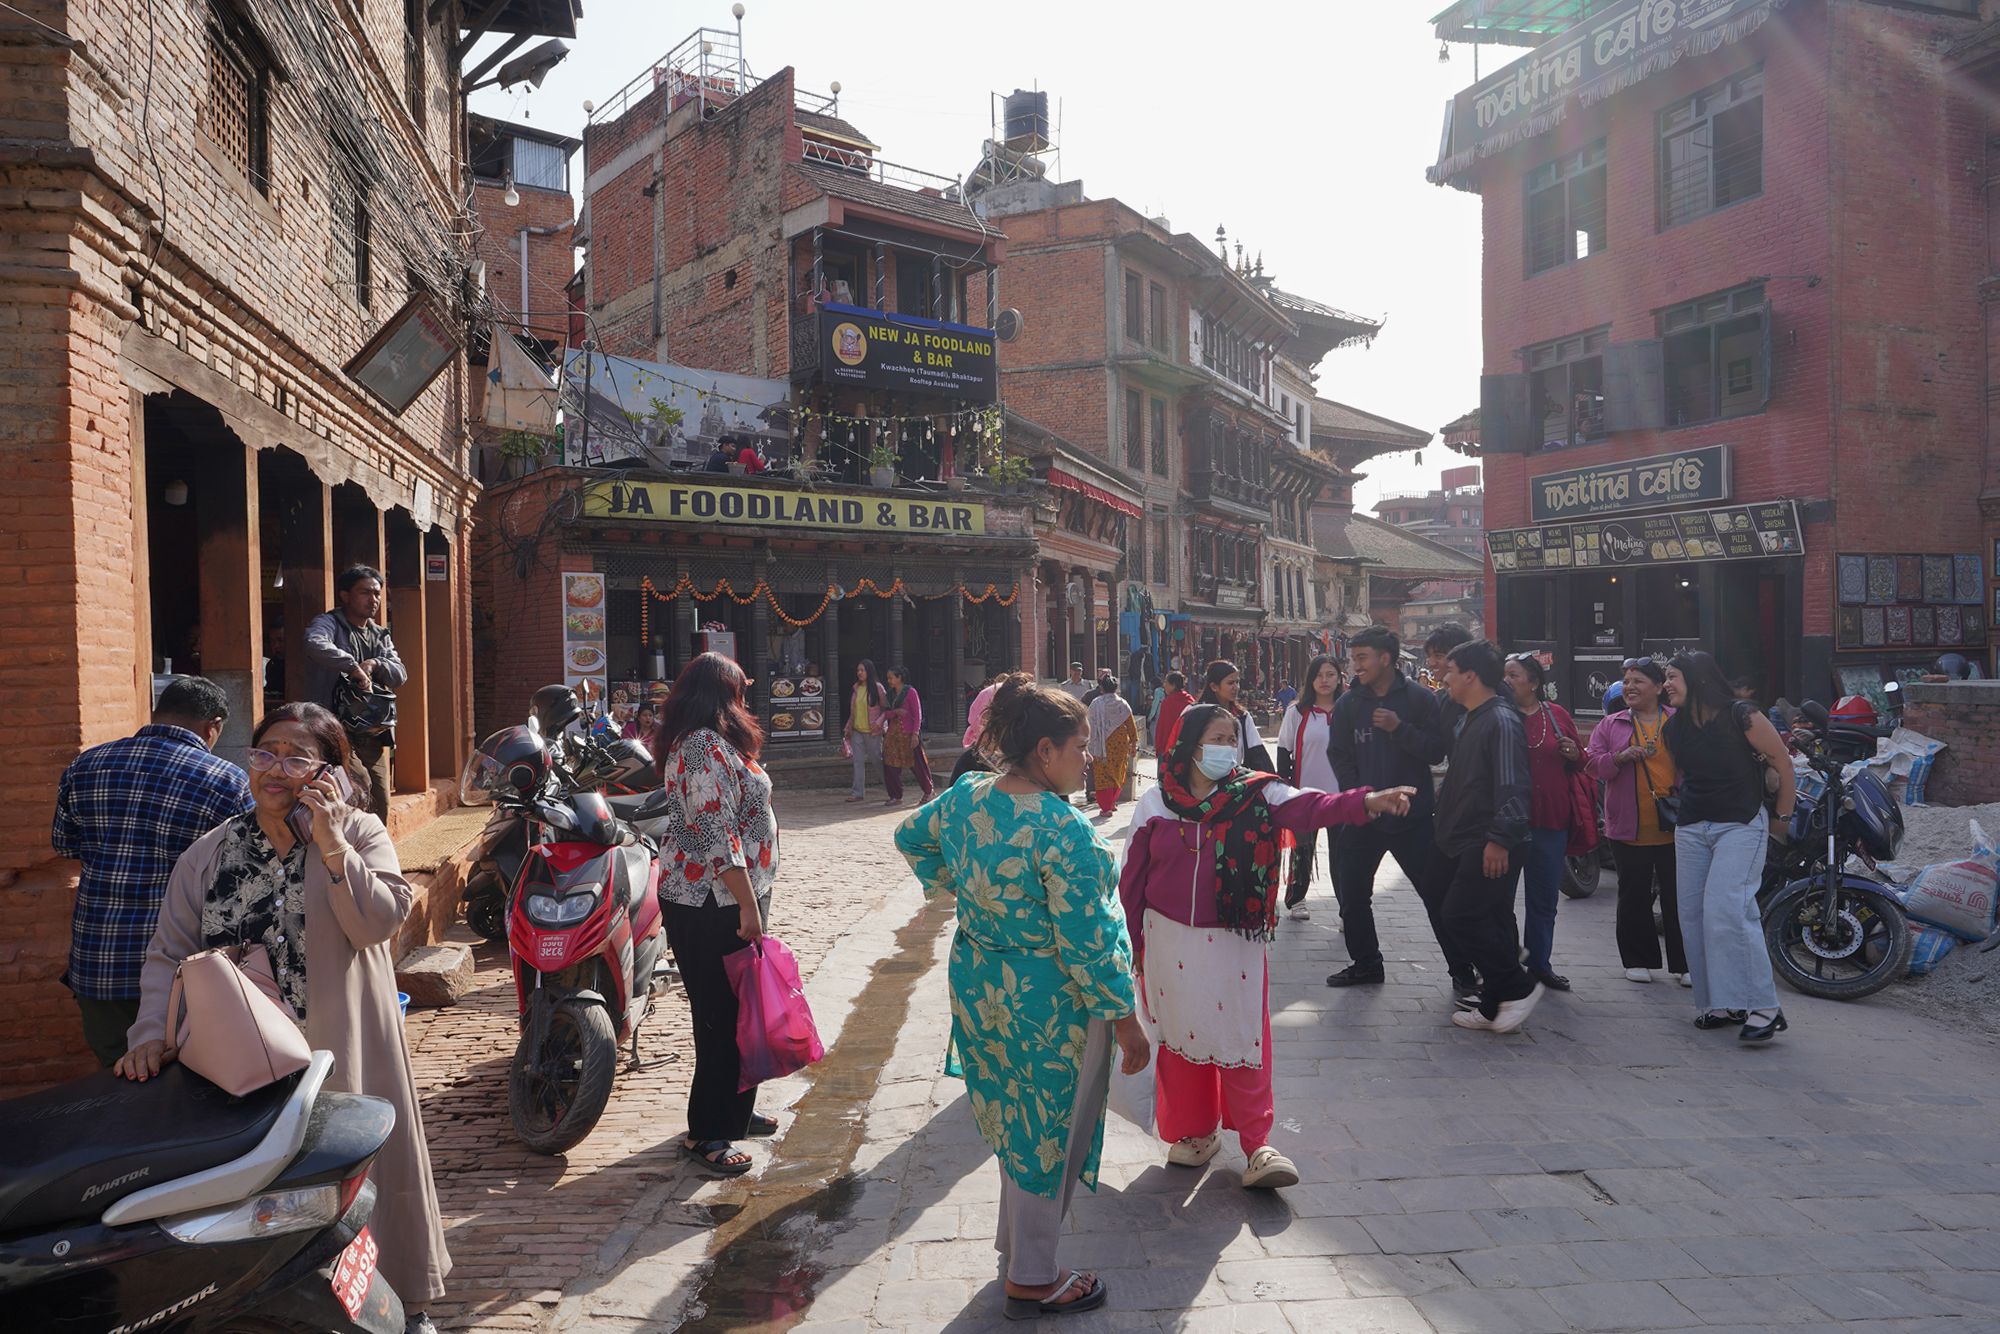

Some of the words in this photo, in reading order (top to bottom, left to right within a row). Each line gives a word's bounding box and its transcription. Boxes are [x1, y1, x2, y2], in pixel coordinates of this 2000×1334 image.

[869, 325, 899, 343] NEW
[904, 331, 920, 346] JA
[924, 334, 992, 356] FOODLAND
[913, 350, 922, 364] &
[927, 352, 953, 368] BAR
[880, 363, 916, 374] Kwachhen
[916, 368, 951, 379] (Taumadi),
[951, 372, 984, 383] Bhaktapur
[909, 377, 933, 387] Rooftop
[933, 380, 960, 389] Available
[608, 486, 654, 514] JA
[670, 489, 864, 525] FOODLAND
[877, 503, 897, 527] &
[909, 504, 973, 531] BAR
[1761, 508, 1785, 518] HOOKAH
[1680, 515, 1707, 525] CHOPSUEY
[1764, 519, 1786, 528] SHISHA
[1655, 528, 1676, 538] CHICKEN
[1686, 526, 1706, 535] SIZZLER
[1612, 536, 1645, 552] Matina
[1731, 535, 1747, 543] PIZZA
[1730, 544, 1753, 554] BURGER
[80, 1166, 150, 1203] AVIATOR
